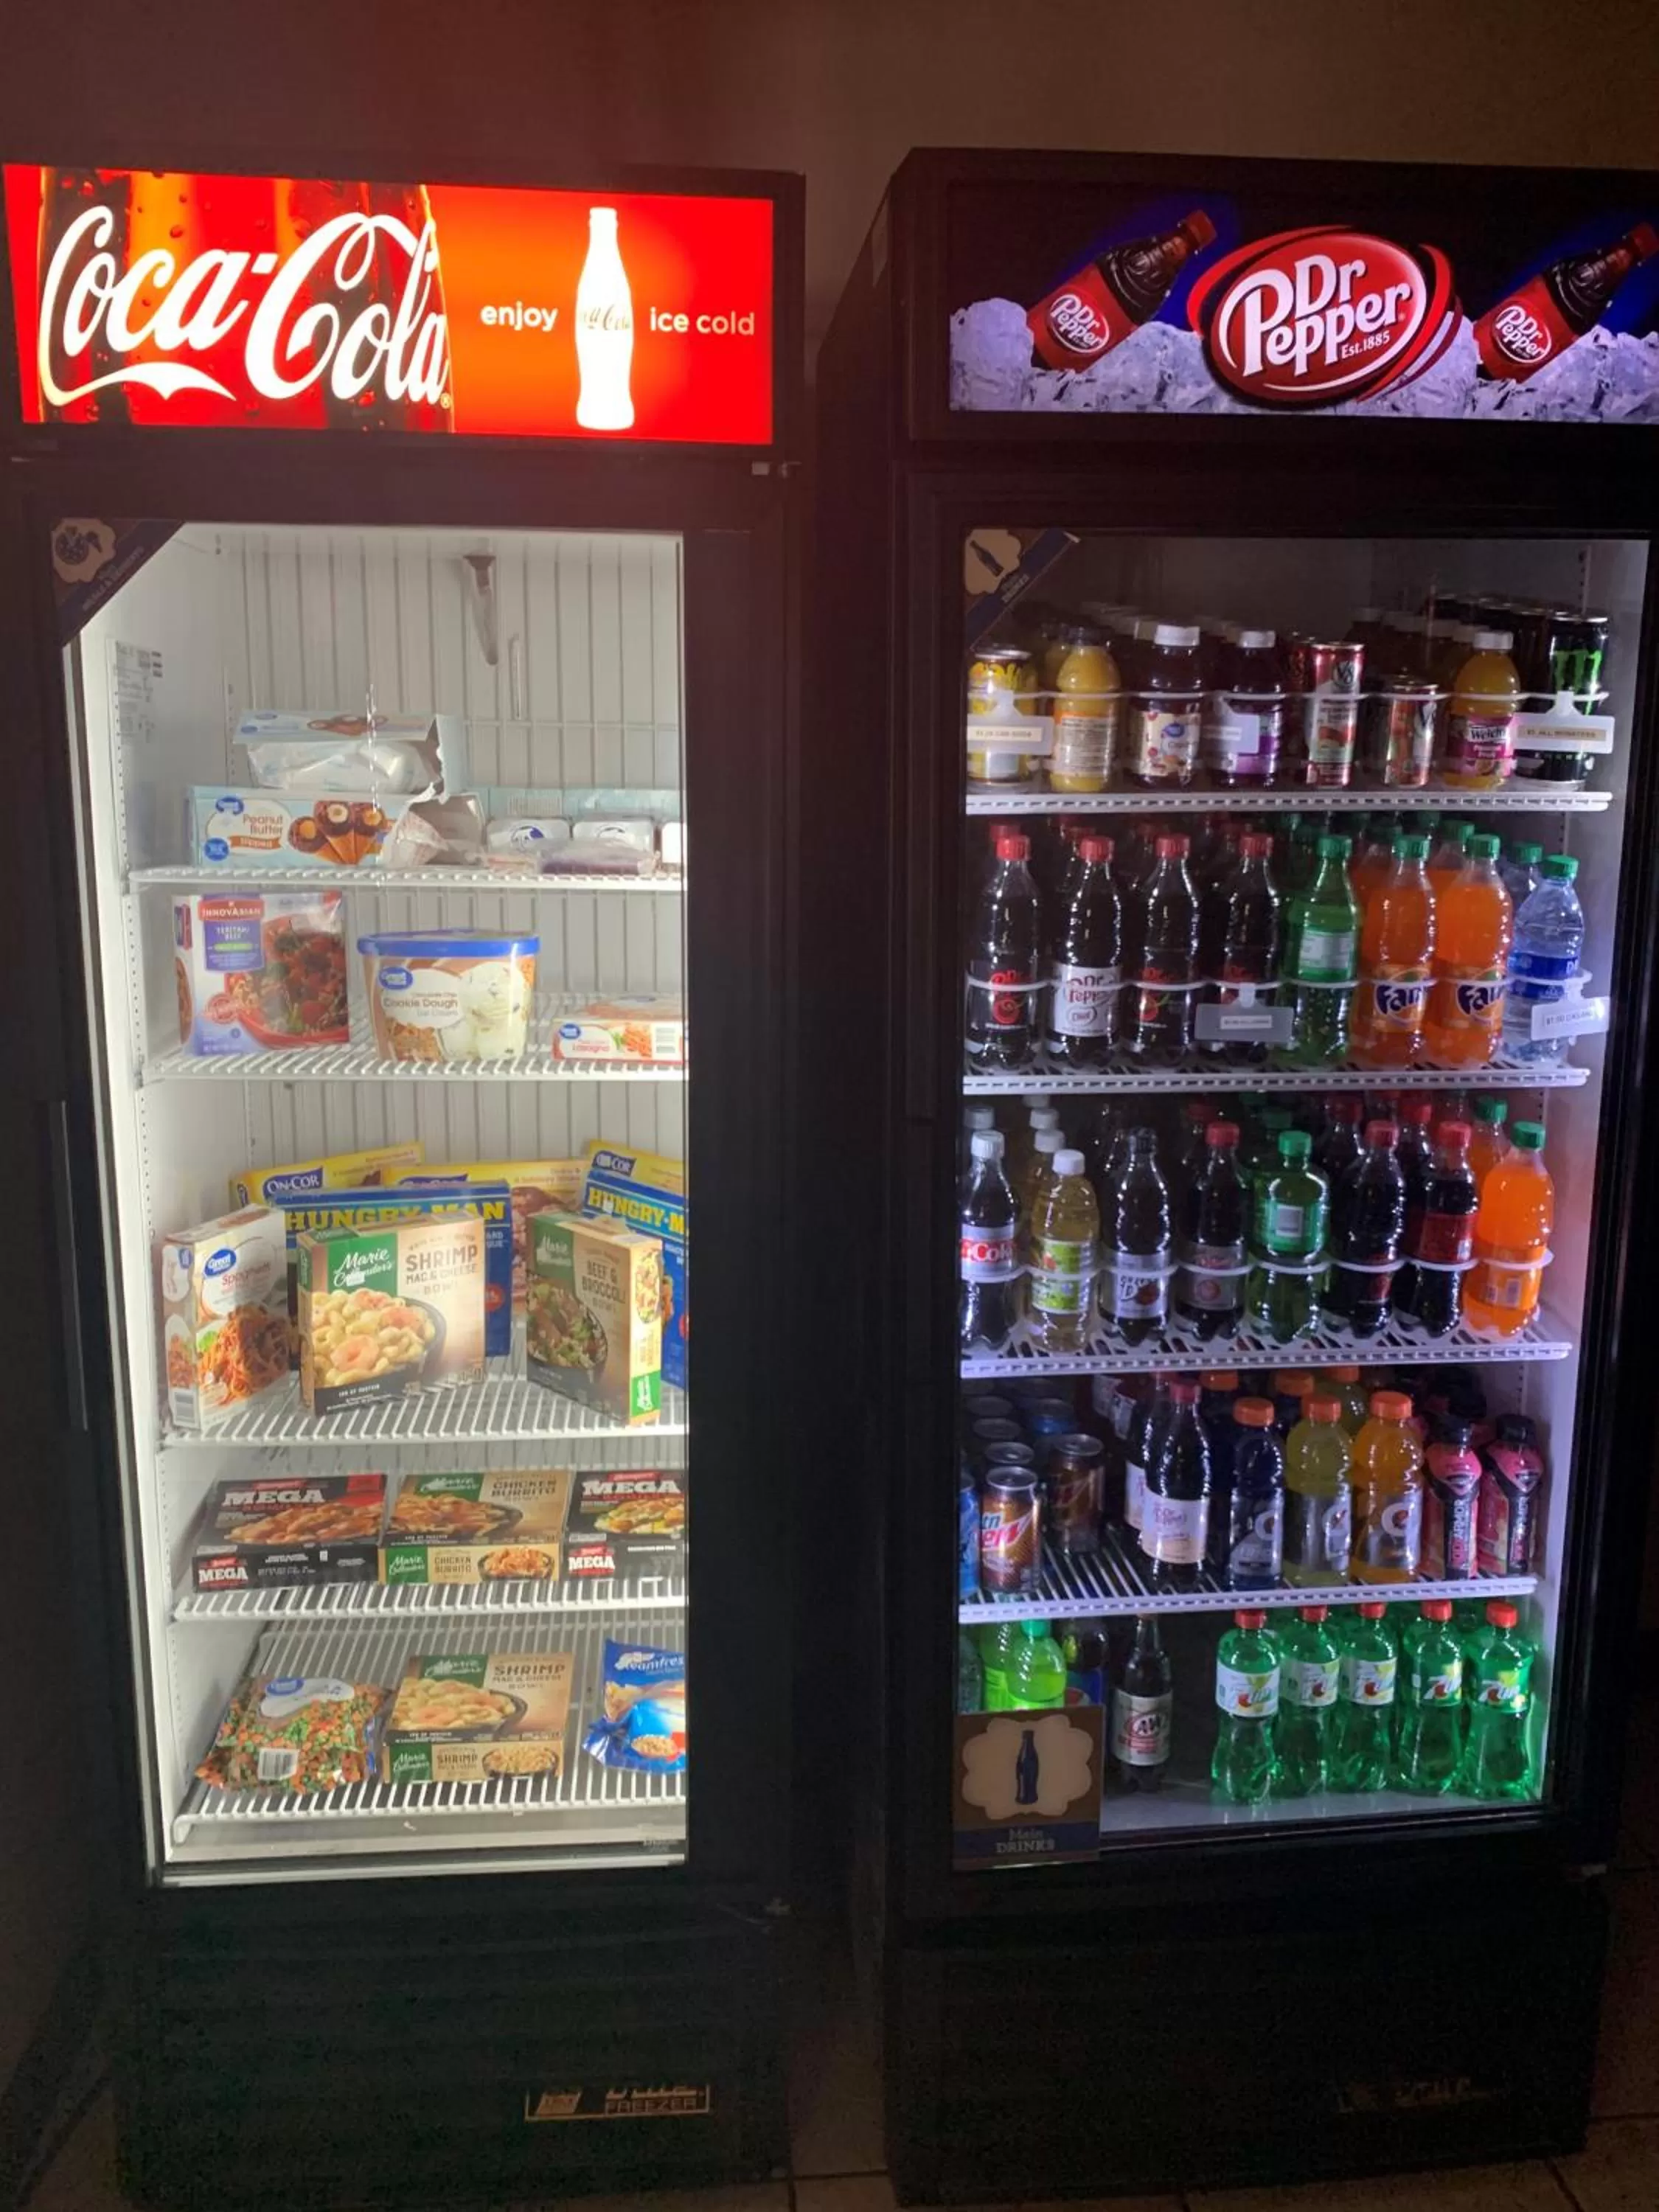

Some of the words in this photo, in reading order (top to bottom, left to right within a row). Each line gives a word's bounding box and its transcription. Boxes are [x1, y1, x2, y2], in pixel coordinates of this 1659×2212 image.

[1294, 254, 1366, 320] Dr
[40, 206, 449, 406] Coca-Cola
[480, 301, 558, 332] enjoy
[1074, 305, 1102, 331] Dr
[650, 307, 689, 333] ice
[696, 310, 755, 335] cold
[1050, 293, 1105, 347] Pepper
[1219, 268, 1413, 378] Pepper
[1495, 305, 1547, 357] Pepper
[1517, 316, 1543, 341] Dr
[243, 813, 283, 824] Peanut
[334, 1248, 391, 1274] Marie
[406, 1244, 479, 1273] SHRIMP
[223, 1488, 325, 1506] MEGA
[581, 1479, 681, 1496] MEGA
[198, 1567, 248, 1584] MEGA
[568, 1555, 615, 1571] MEGA
[494, 1663, 566, 1676] SHRIMP
